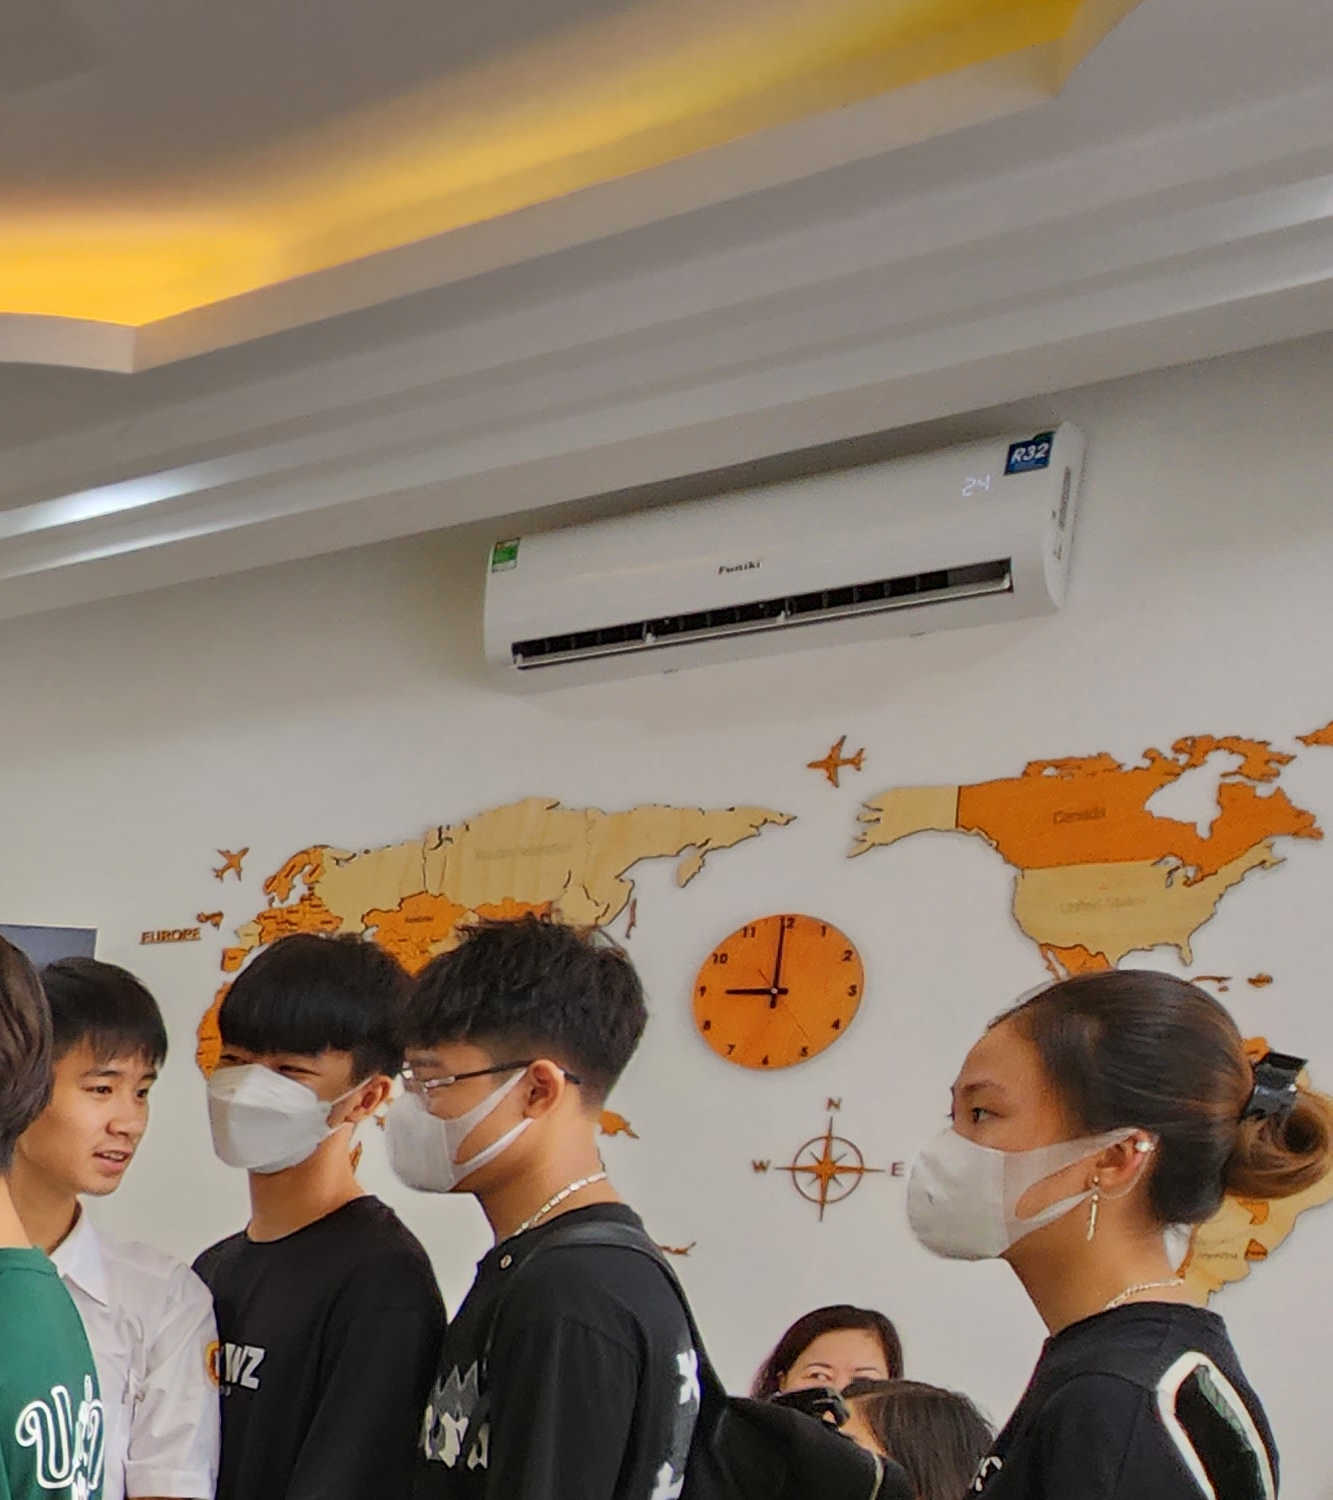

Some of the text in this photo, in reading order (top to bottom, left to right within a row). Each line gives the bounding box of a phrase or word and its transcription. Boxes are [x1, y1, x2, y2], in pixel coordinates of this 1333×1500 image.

[1011, 442, 1049, 464] R32
[962, 475, 990, 496] 24
[140, 928, 203, 944] EUROPE
[742, 926, 756, 938] 11
[820, 925, 827, 937] 1
[712, 953, 728, 964] 10
[841, 950, 853, 961] 2
[847, 985, 857, 996] 3
[702, 1020, 712, 1031] 8
[831, 1018, 841, 1030] 4
[726, 1044, 736, 1055] 7
[826, 1097, 842, 1111] N
[751, 1159, 771, 1174] W
[891, 1161, 905, 1176] E
